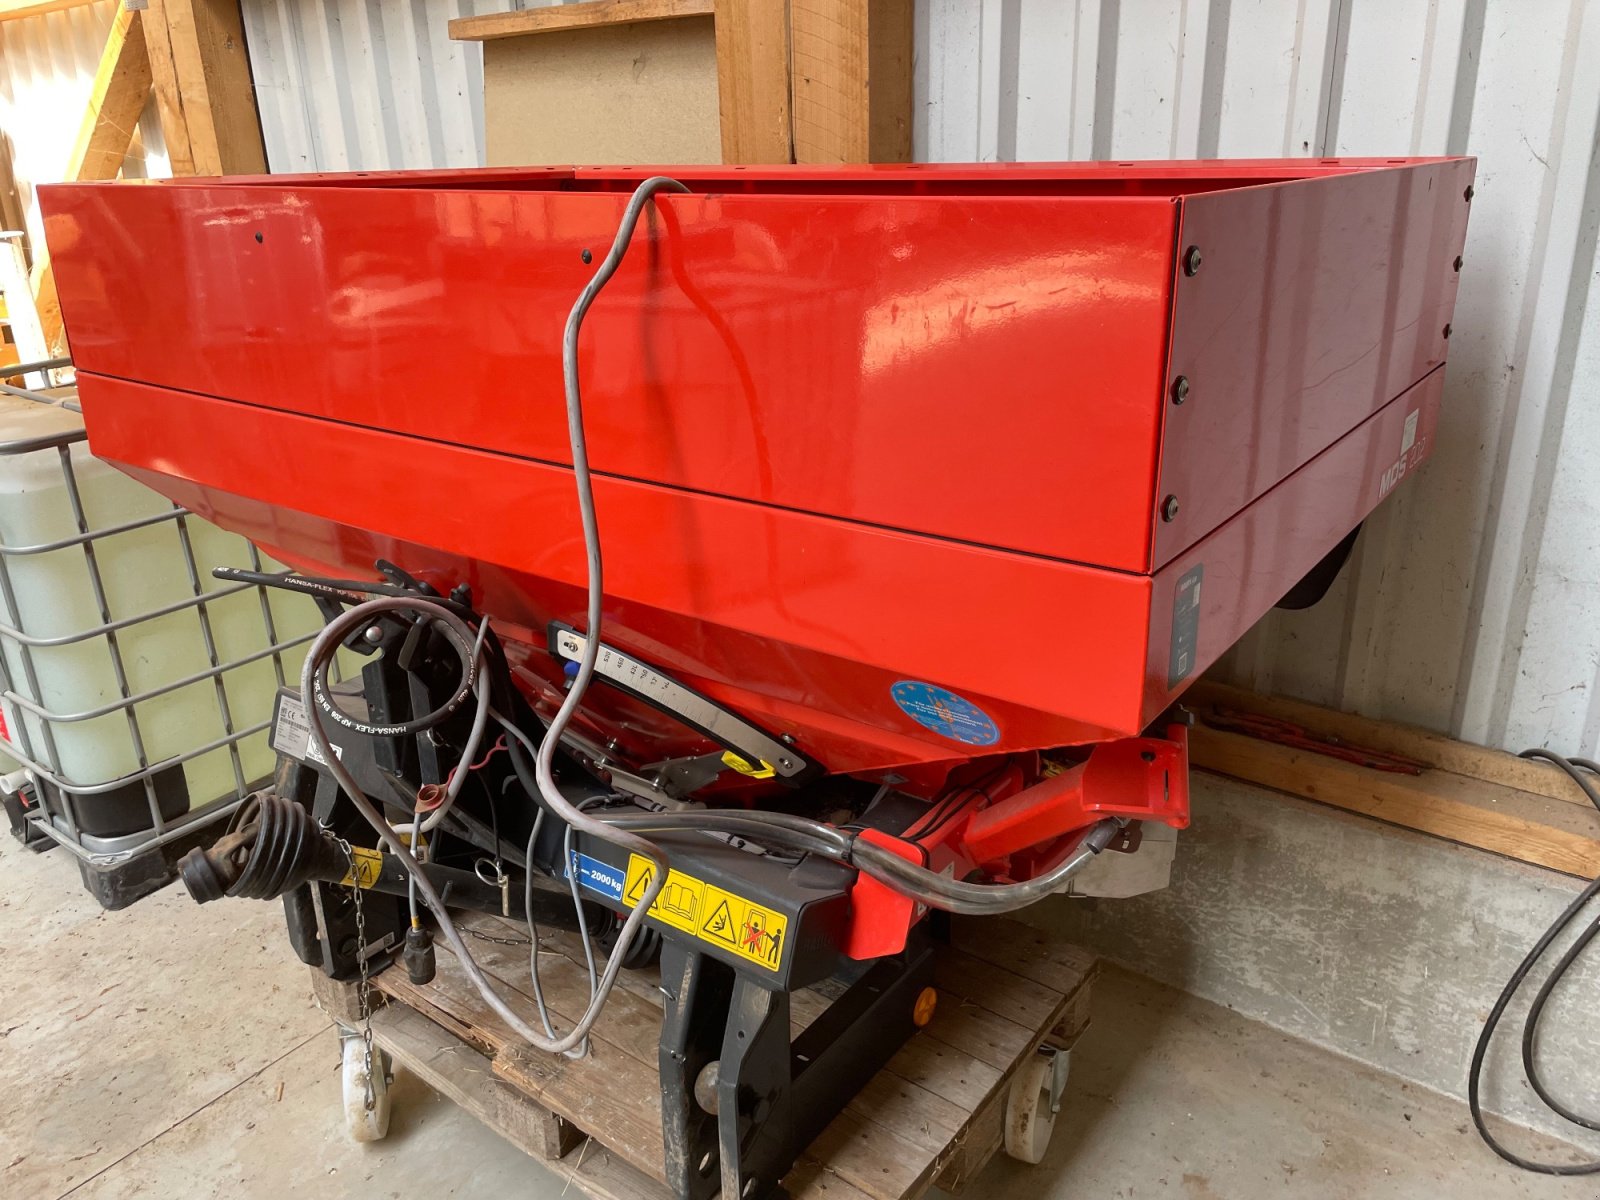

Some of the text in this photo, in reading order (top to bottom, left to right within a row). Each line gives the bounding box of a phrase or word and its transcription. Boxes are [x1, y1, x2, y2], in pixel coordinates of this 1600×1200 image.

[1379, 453, 1408, 499] MDS
[284, 576, 333, 593] HANSA-FLEX
[341, 718, 352, 727] KP
[355, 723, 407, 735] HANSA-FLEX
[591, 870, 611, 885] 2000
[611, 878, 622, 892] kg
